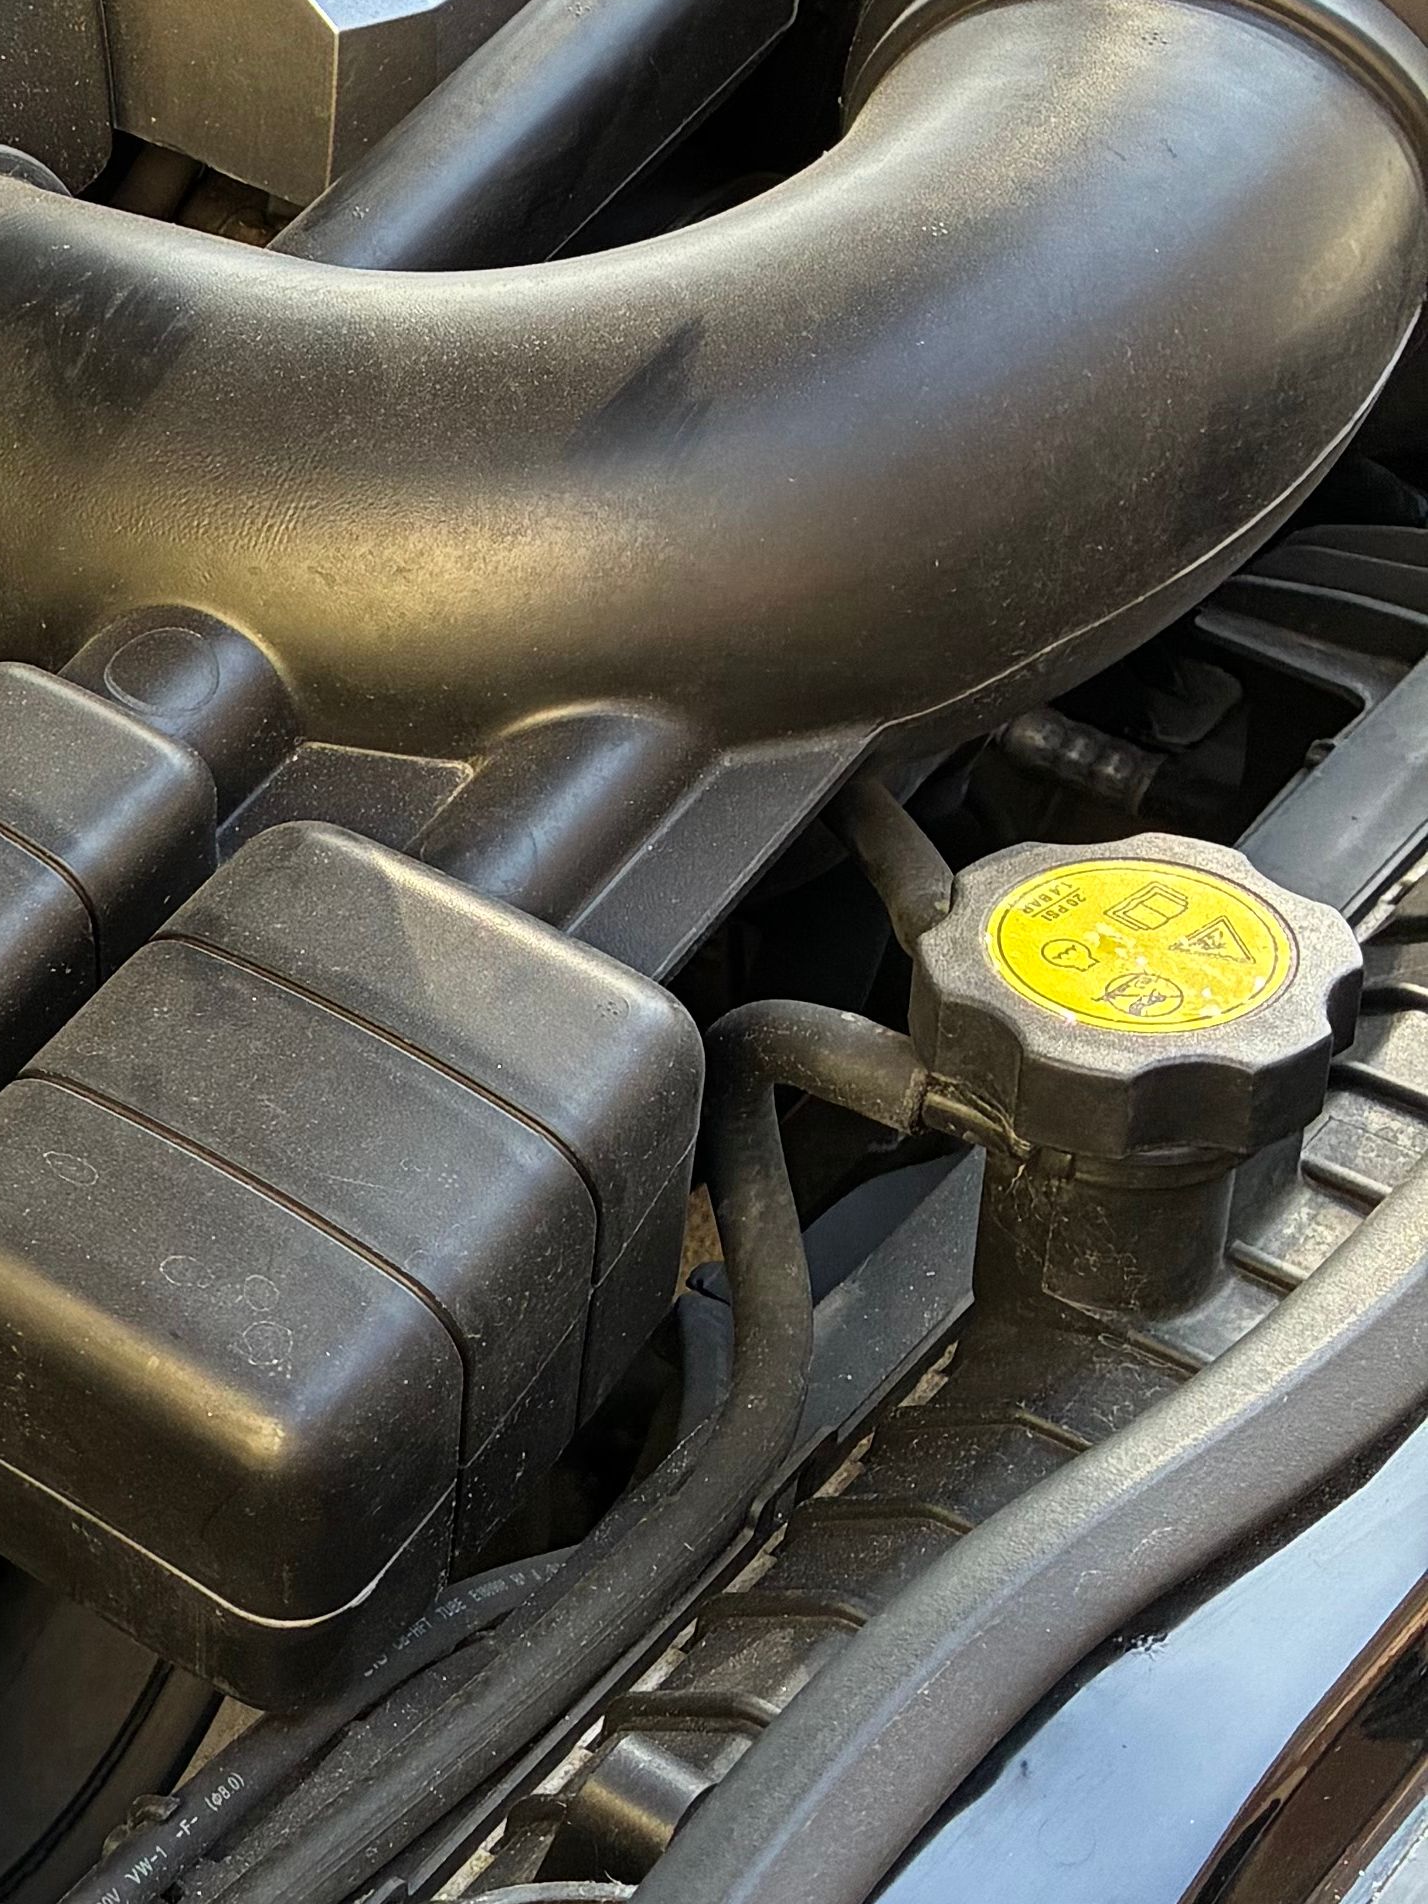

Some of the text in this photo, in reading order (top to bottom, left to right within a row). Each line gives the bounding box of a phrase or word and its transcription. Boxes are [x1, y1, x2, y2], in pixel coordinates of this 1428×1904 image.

[1022, 893, 1053, 914] BAR
[1040, 893, 1087, 922] 20 PSI
[124, 1845, 168, 1886] VW-1
